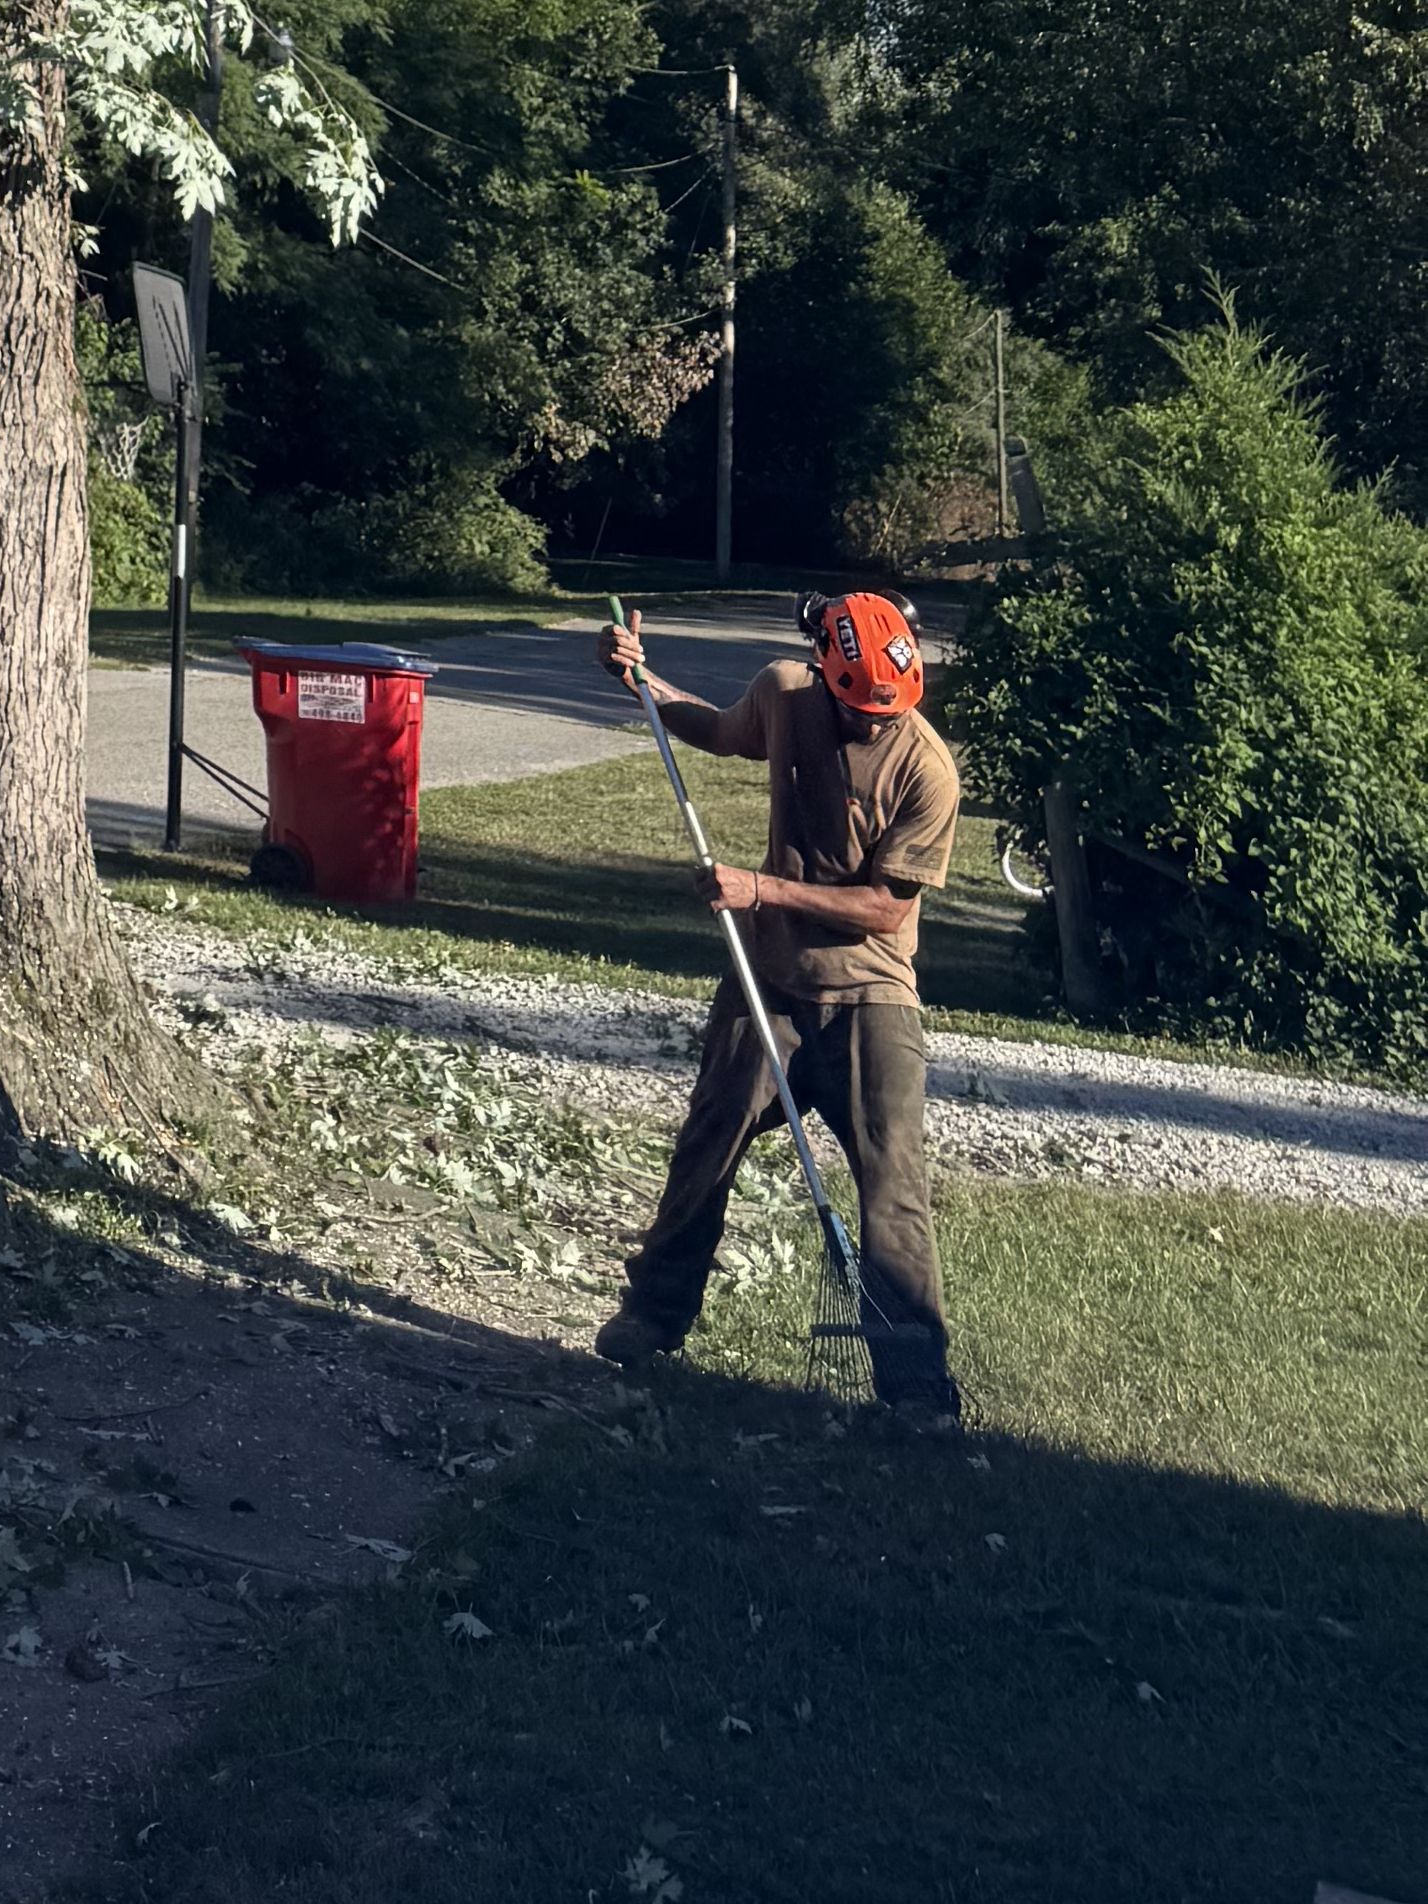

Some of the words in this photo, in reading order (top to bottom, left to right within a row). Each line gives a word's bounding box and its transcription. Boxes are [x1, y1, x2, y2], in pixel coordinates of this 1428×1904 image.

[839, 617, 859, 657] YETI
[329, 674, 362, 686] MAC
[300, 683, 362, 697] DISPOSAL
